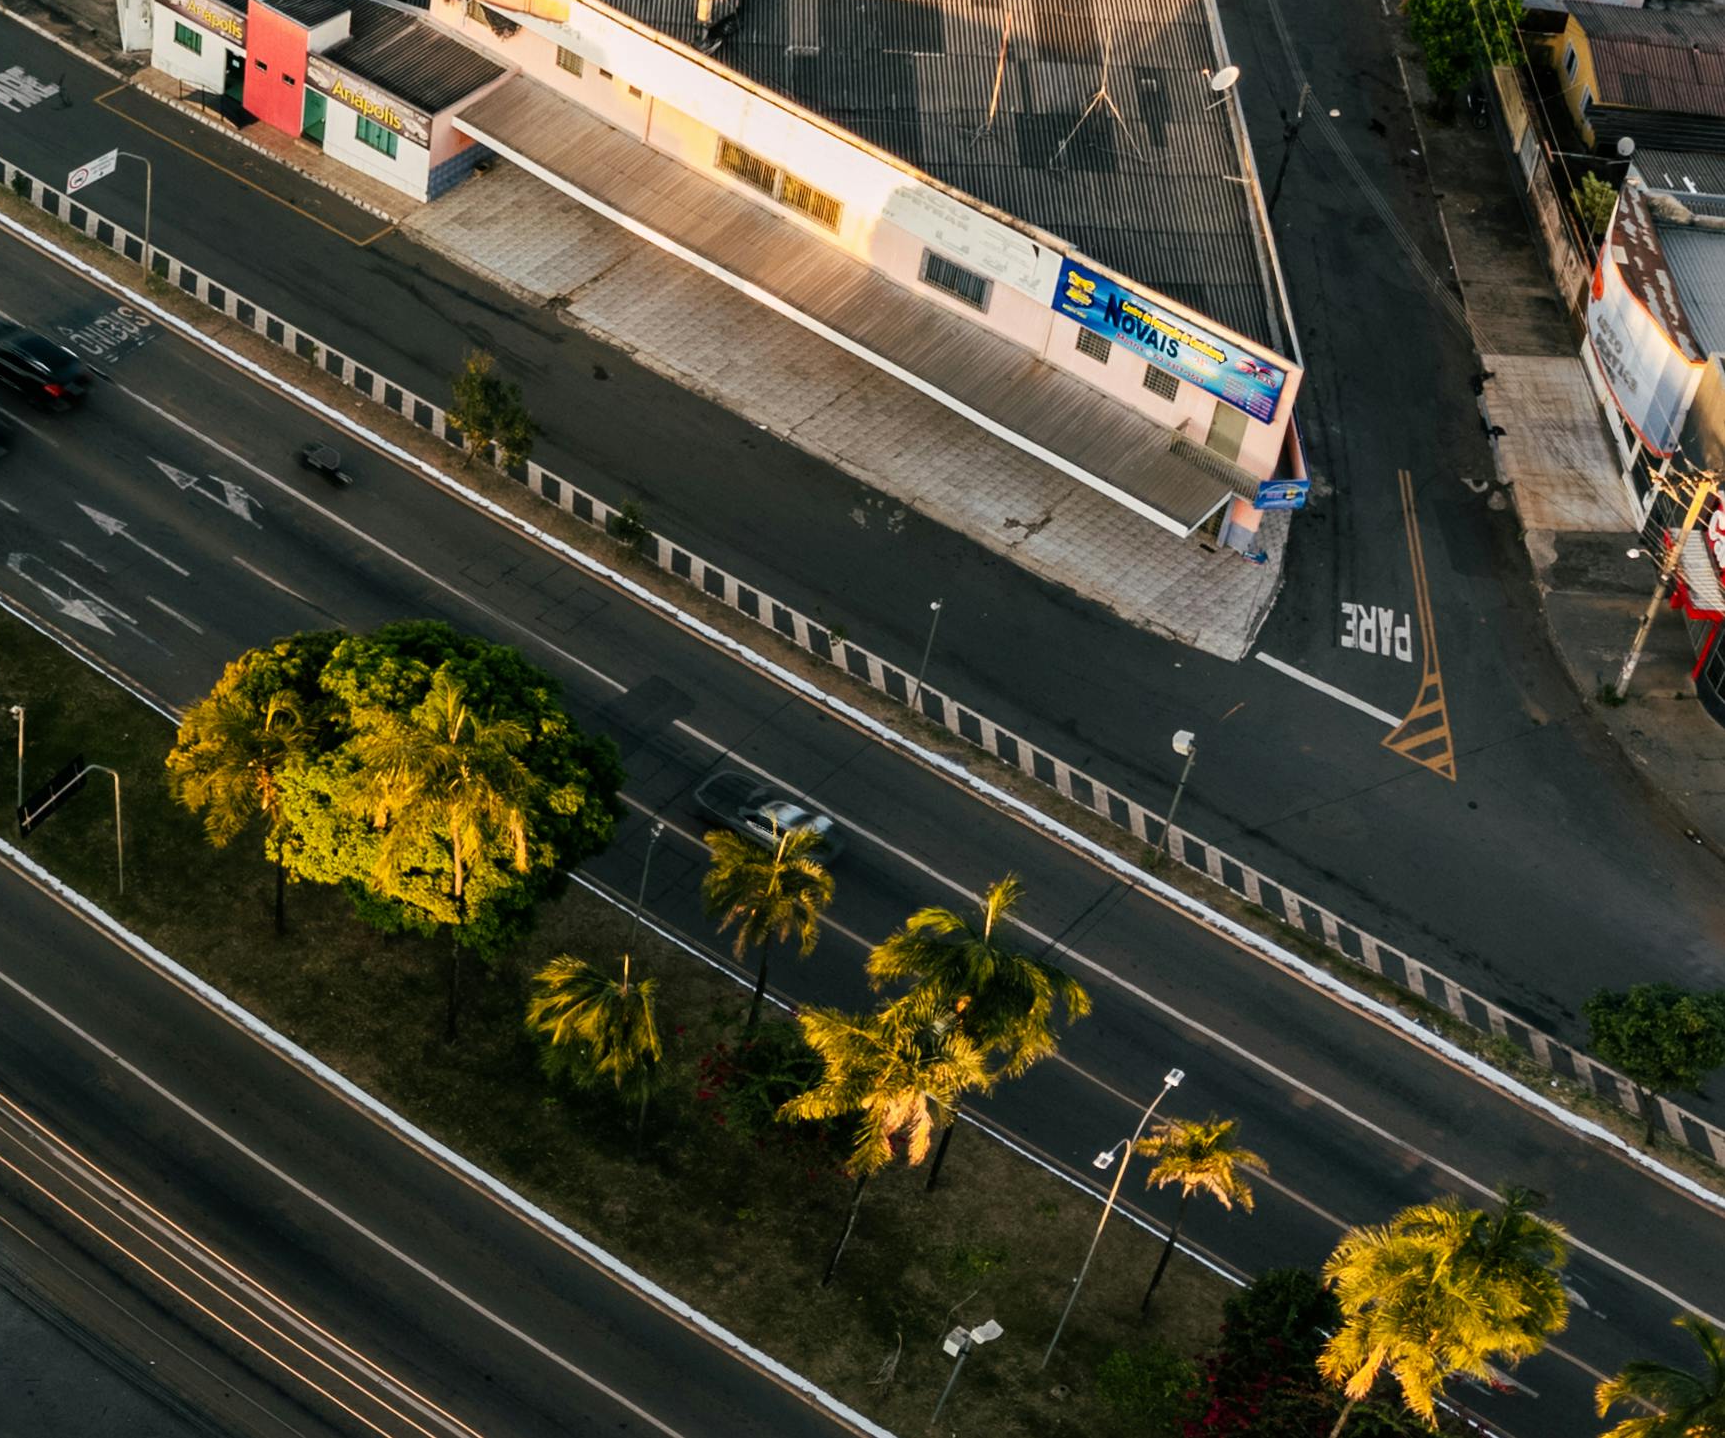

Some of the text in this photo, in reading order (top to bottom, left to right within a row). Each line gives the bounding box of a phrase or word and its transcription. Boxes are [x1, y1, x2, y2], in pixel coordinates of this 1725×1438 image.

[332, 78, 403, 131] Anápolis
[57, 306, 152, 356] ÔNIBUS
[1340, 601, 1413, 663] PARE
